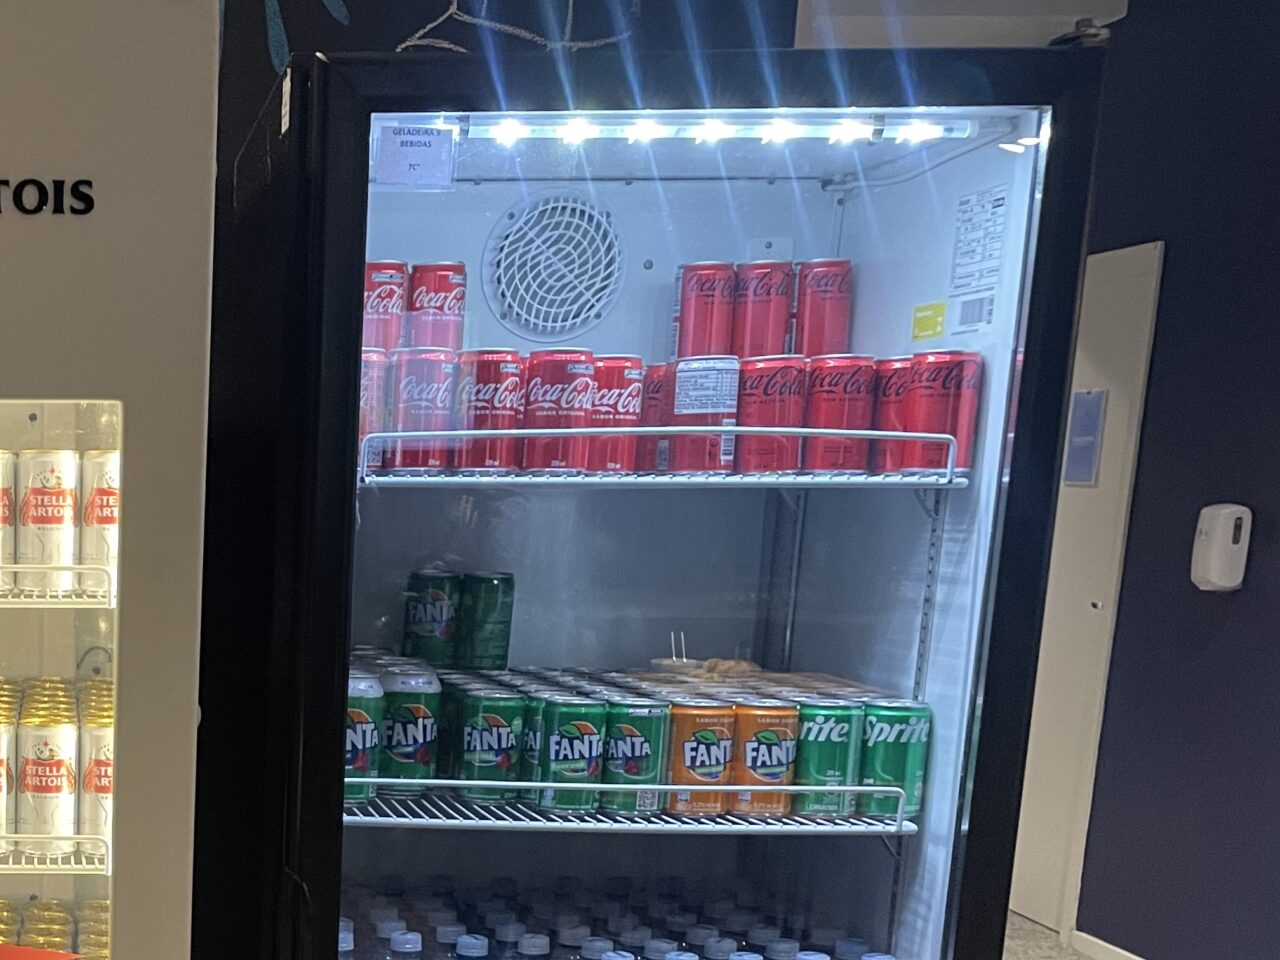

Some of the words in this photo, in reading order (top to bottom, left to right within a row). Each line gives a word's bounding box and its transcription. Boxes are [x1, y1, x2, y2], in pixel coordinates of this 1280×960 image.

[399, 140, 433, 149] BEBIDAS
[412, 285, 466, 316] Coca-Co
[398, 374, 453, 410] Coca-Co
[457, 375, 521, 409] Coca-Co
[590, 381, 642, 414] Coca-Co
[29, 495, 73, 506] STELLA
[29, 506, 74, 517] ARTOIS
[94, 506, 119, 517] ART
[95, 495, 119, 506] STE
[346, 722, 379, 750] NTA
[382, 716, 438, 746] FANTA
[463, 725, 516, 750] FANTA
[800, 715, 849, 742] rite
[549, 733, 603, 760] FANTA
[683, 739, 733, 767] FANT
[745, 739, 796, 767] FANT
[25, 776, 67, 786] ARTOIS
[26, 766, 67, 776] STELLA
[94, 766, 113, 776] STE
[94, 776, 113, 786] ART
